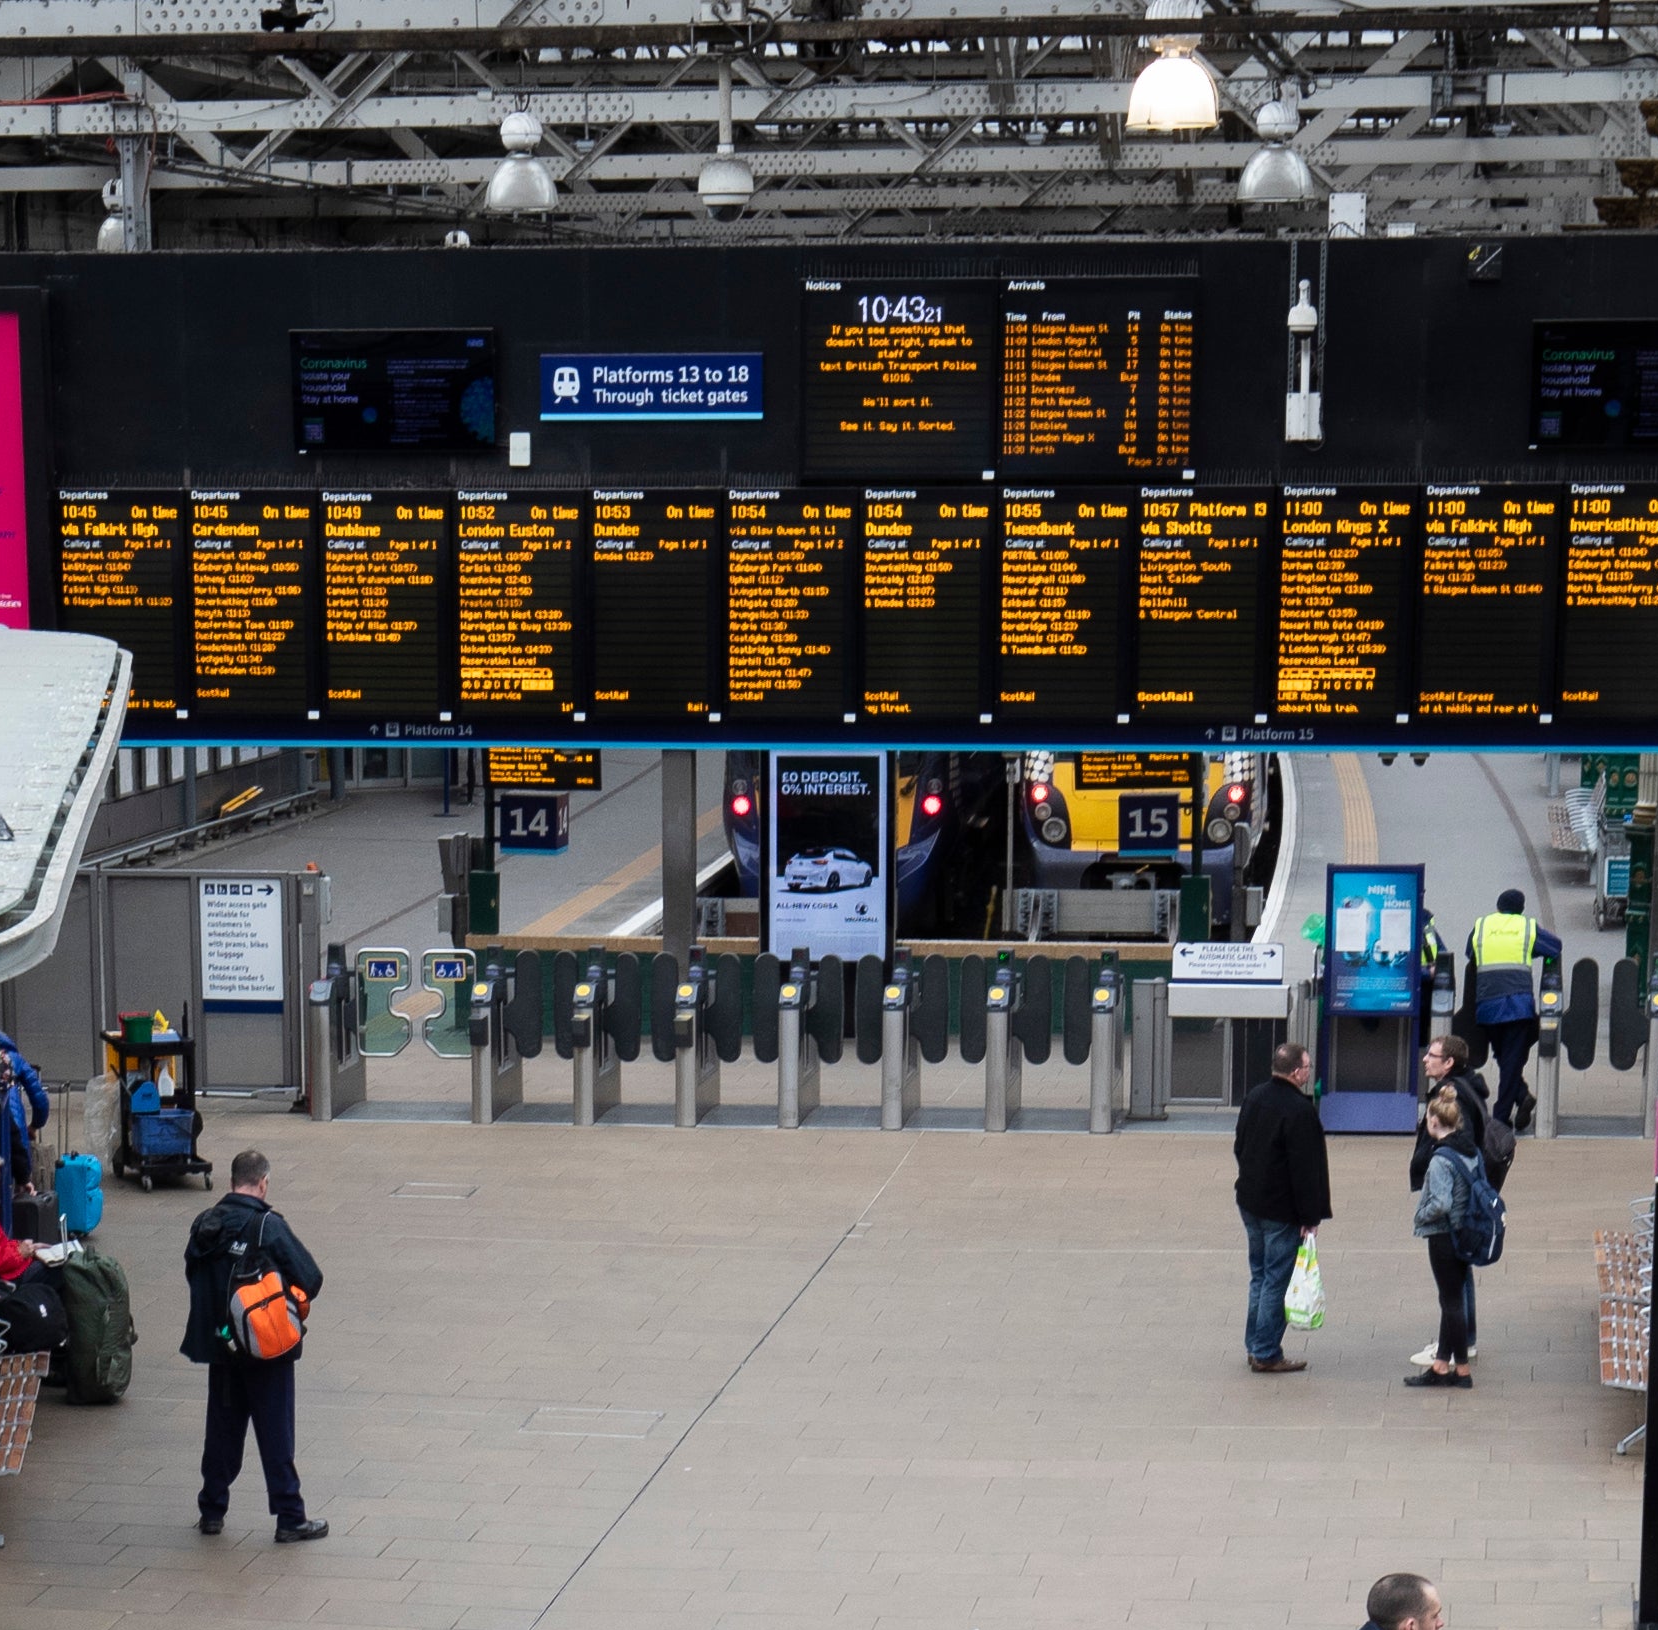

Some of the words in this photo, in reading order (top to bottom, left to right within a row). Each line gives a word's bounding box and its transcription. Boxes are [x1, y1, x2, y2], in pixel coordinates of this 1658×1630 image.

[806, 281, 841, 291] Notices
[1008, 280, 1046, 291] Arrivals
[593, 366, 674, 384] Platforms
[679, 366, 700, 384] 13
[704, 366, 722, 384] to
[727, 366, 749, 384] 18
[593, 388, 654, 406] Through
[661, 388, 704, 404] ticket
[707, 389, 748, 407] gates
[59, 491, 108, 501] Departures
[191, 491, 240, 501] Departures
[1284, 486, 1337, 496] Departures
[62, 506, 96, 519] 10:45
[194, 506, 228, 519] 10:45
[326, 507, 362, 520] 10:49
[460, 506, 495, 519] 10:52
[595, 506, 631, 519] 10:53
[731, 506, 766, 519] 10:54
[867, 505, 903, 518] 10:54
[1005, 504, 1041, 518] 10:55
[1143, 504, 1178, 518] 10:57
[1189, 504, 1247, 518] Platform
[1255, 504, 1268, 517] 13
[1286, 502, 1323, 516] 11:00
[1428, 501, 1465, 515] 11:00
[1572, 500, 1610, 514] 11:00
[62, 524, 79, 536] via
[84, 523, 127, 536] Falkirk
[133, 523, 158, 537] High
[192, 523, 259, 536] Cardenden
[325, 524, 381, 537] Dunblane
[459, 524, 505, 537] London
[510, 524, 554, 537] Euston
[594, 523, 640, 537] Dundee
[865, 522, 912, 536] Dundee
[1004, 522, 1075, 536] Tweedbank
[1141, 523, 1160, 535] via
[1166, 522, 1212, 536] Shotts
[1283, 520, 1330, 534] London
[1337, 520, 1372, 535] Kings
[1378, 520, 1388, 533] X
[1426, 521, 1445, 533] via
[1451, 520, 1497, 533] Falkirk
[1503, 520, 1532, 535] High
[1570, 518, 1658, 533] Inverkeithing
[404, 724, 456, 737] Platform
[458, 725, 473, 737] 14
[1242, 728, 1295, 741] Platform
[1299, 729, 1314, 740] 15
[782, 772, 798, 783] £0
[801, 772, 861, 783] DEPOSIT.
[782, 783, 801, 795] 0%
[803, 783, 871, 796] INTEREST.
[509, 808, 549, 837] 14
[1128, 808, 1168, 838] 15
[252, 901, 267, 909] gate
